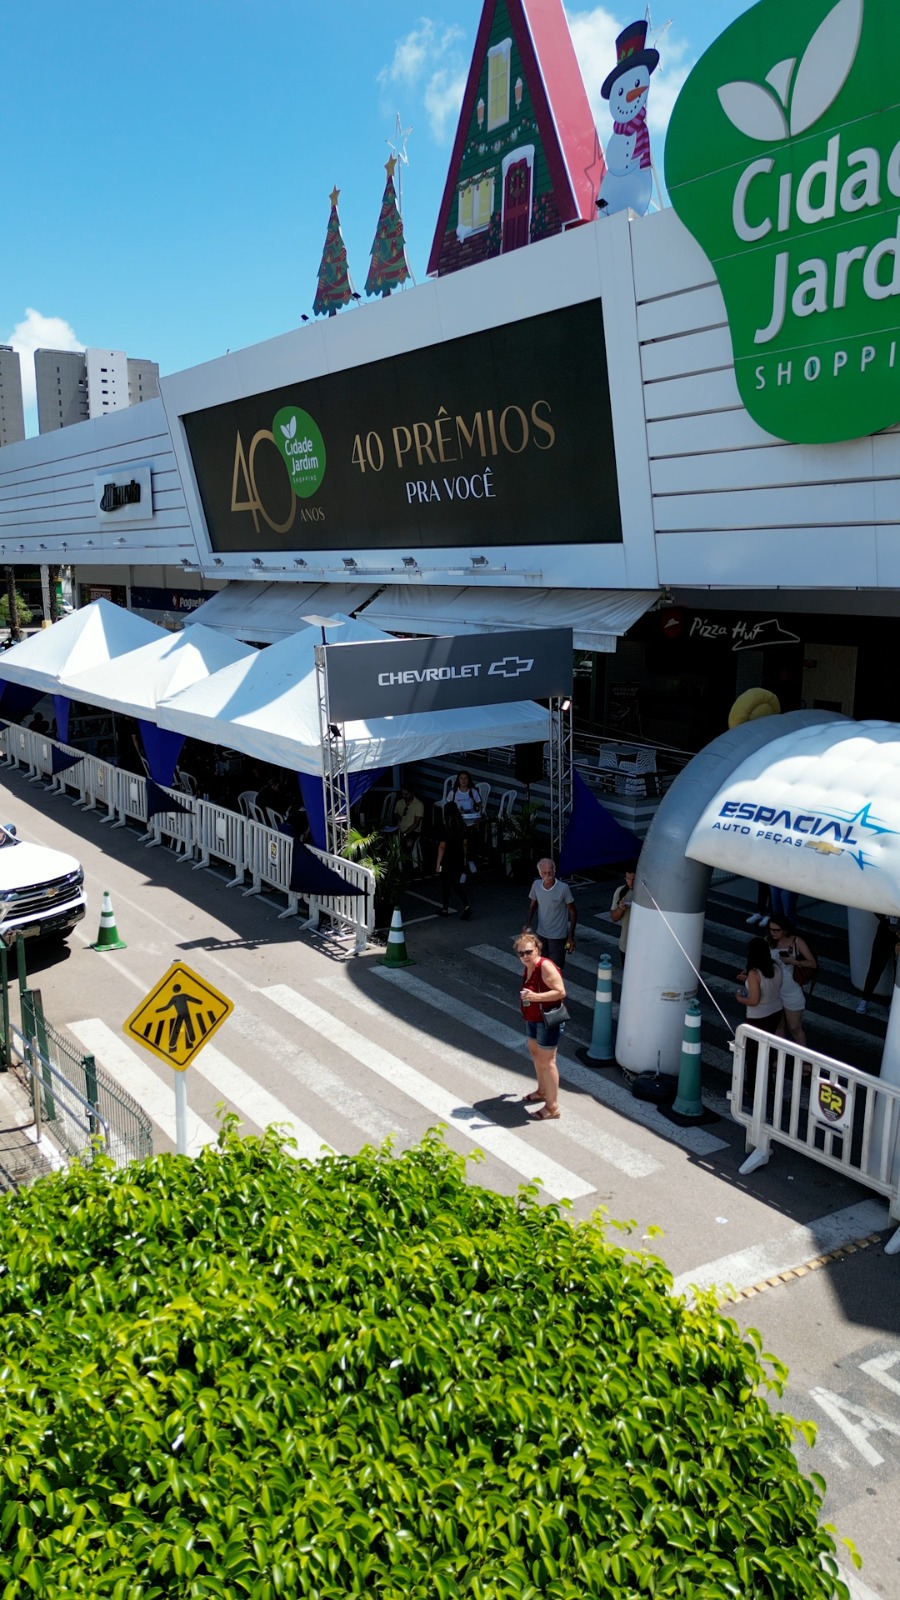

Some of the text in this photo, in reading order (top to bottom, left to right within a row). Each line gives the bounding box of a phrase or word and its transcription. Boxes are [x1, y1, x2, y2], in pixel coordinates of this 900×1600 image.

[284, 437, 313, 456] Cidade
[351, 400, 556, 473] 40 PRÊMIOS
[292, 455, 319, 475] Jardim
[230, 429, 297, 533] 40
[405, 467, 497, 504] PRA VOCÊ
[300, 506, 326, 522] ANOS
[689, 617, 764, 640] Pizza Hut
[378, 663, 482, 686] CHEVROLET
[712, 822, 803, 847] AUTO PEÇAS
[718, 801, 858, 845] ESPACIAL
[820, 1084, 843, 1114] BR
